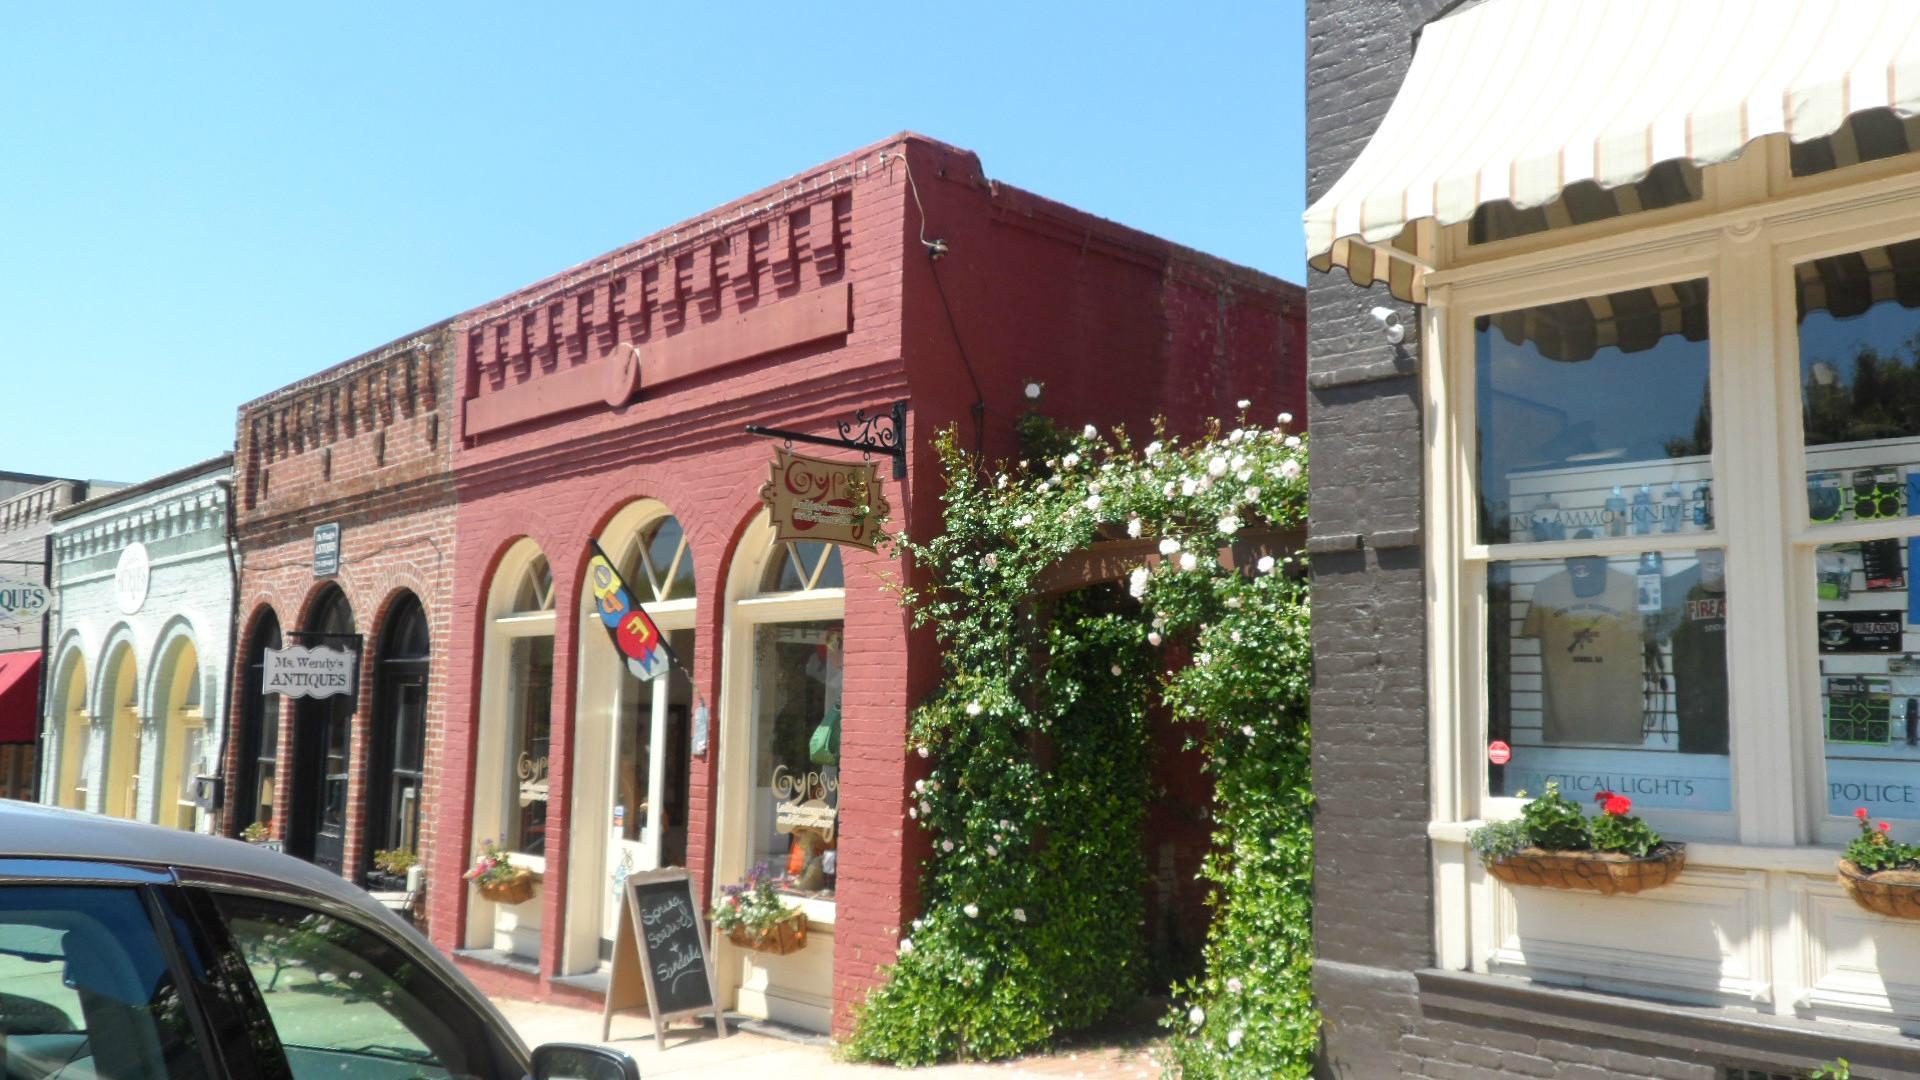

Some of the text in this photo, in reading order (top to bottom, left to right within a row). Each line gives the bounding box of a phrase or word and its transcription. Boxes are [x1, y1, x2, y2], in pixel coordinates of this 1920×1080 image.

[1553, 510, 1615, 526] AMMO
[297, 657, 344, 671] Wendy's
[270, 672, 346, 688] ANTIQUES
[771, 764, 840, 824] Gypsy
[1621, 776, 1694, 796] LIGHTS
[1830, 783, 1915, 803] POLICE
